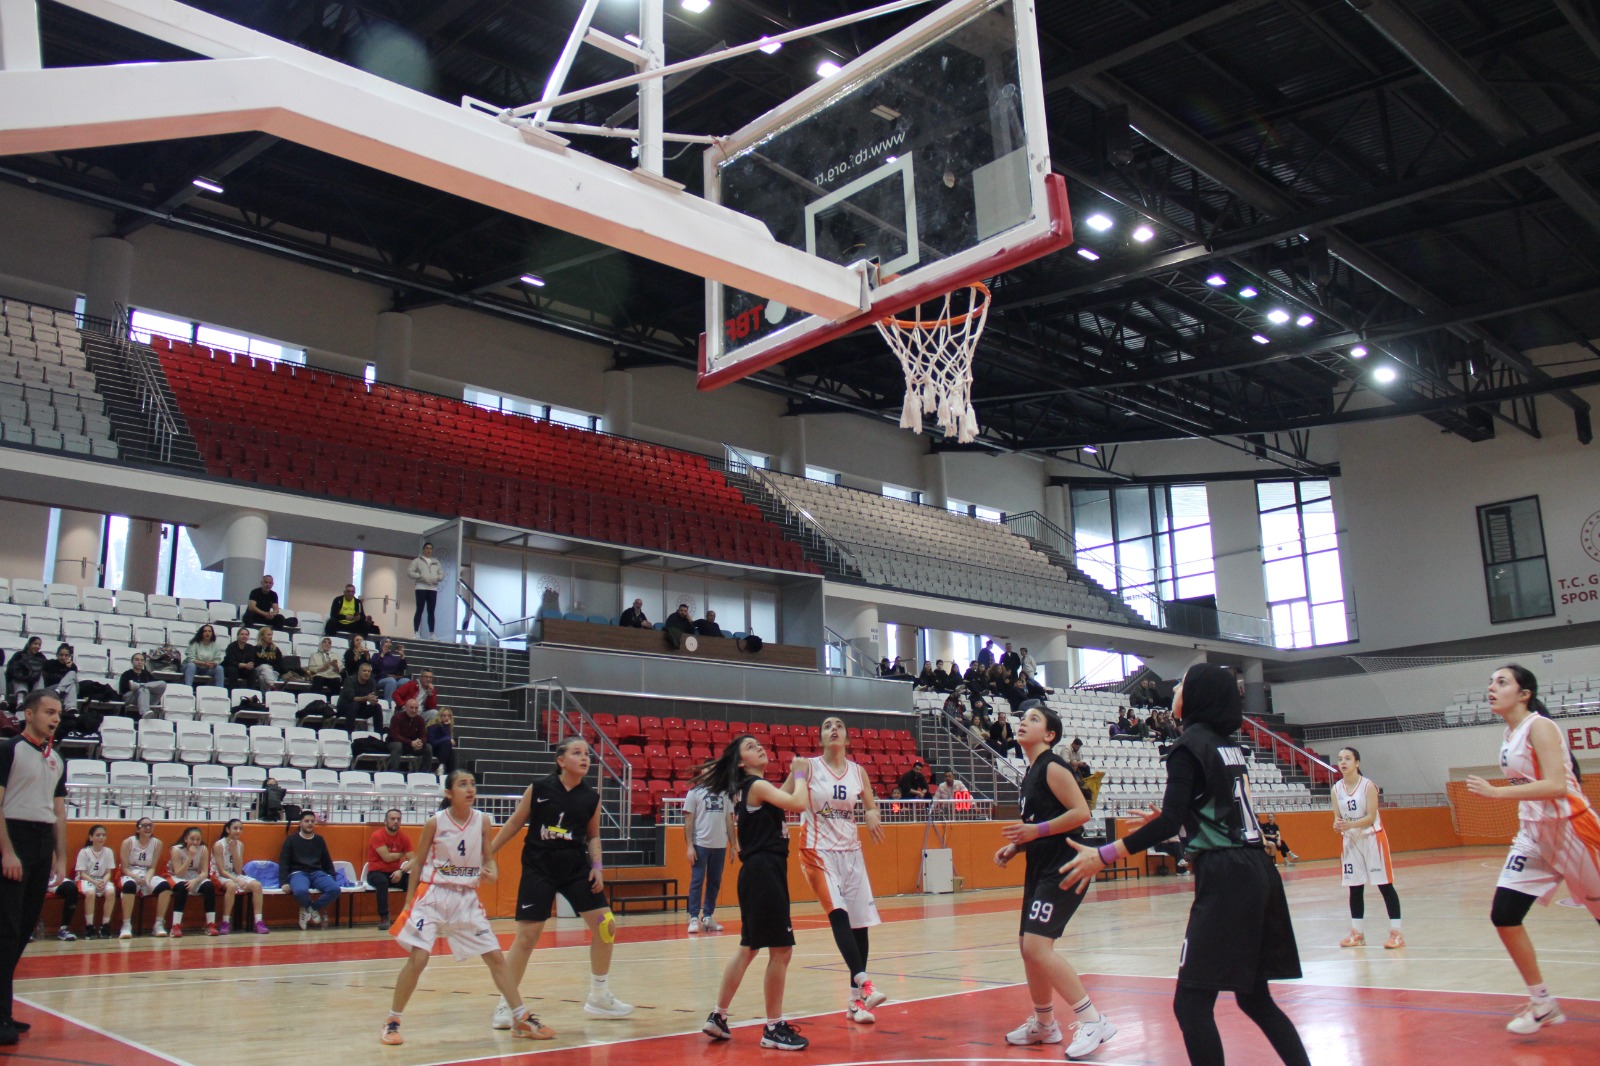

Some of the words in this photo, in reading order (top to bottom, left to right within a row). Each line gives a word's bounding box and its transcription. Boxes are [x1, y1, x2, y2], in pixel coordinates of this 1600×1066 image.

[1558, 577, 1585, 590] T.C.
[1561, 589, 1598, 605] SPOR
[832, 784, 847, 800] 16
[1347, 799, 1357, 811] 13
[556, 812, 565, 828] 1
[457, 839, 466, 856] 4
[1343, 863, 1353, 874] 13
[1505, 855, 1527, 873] 15
[1029, 900, 1053, 923] 99
[416, 918, 425, 932] 4
